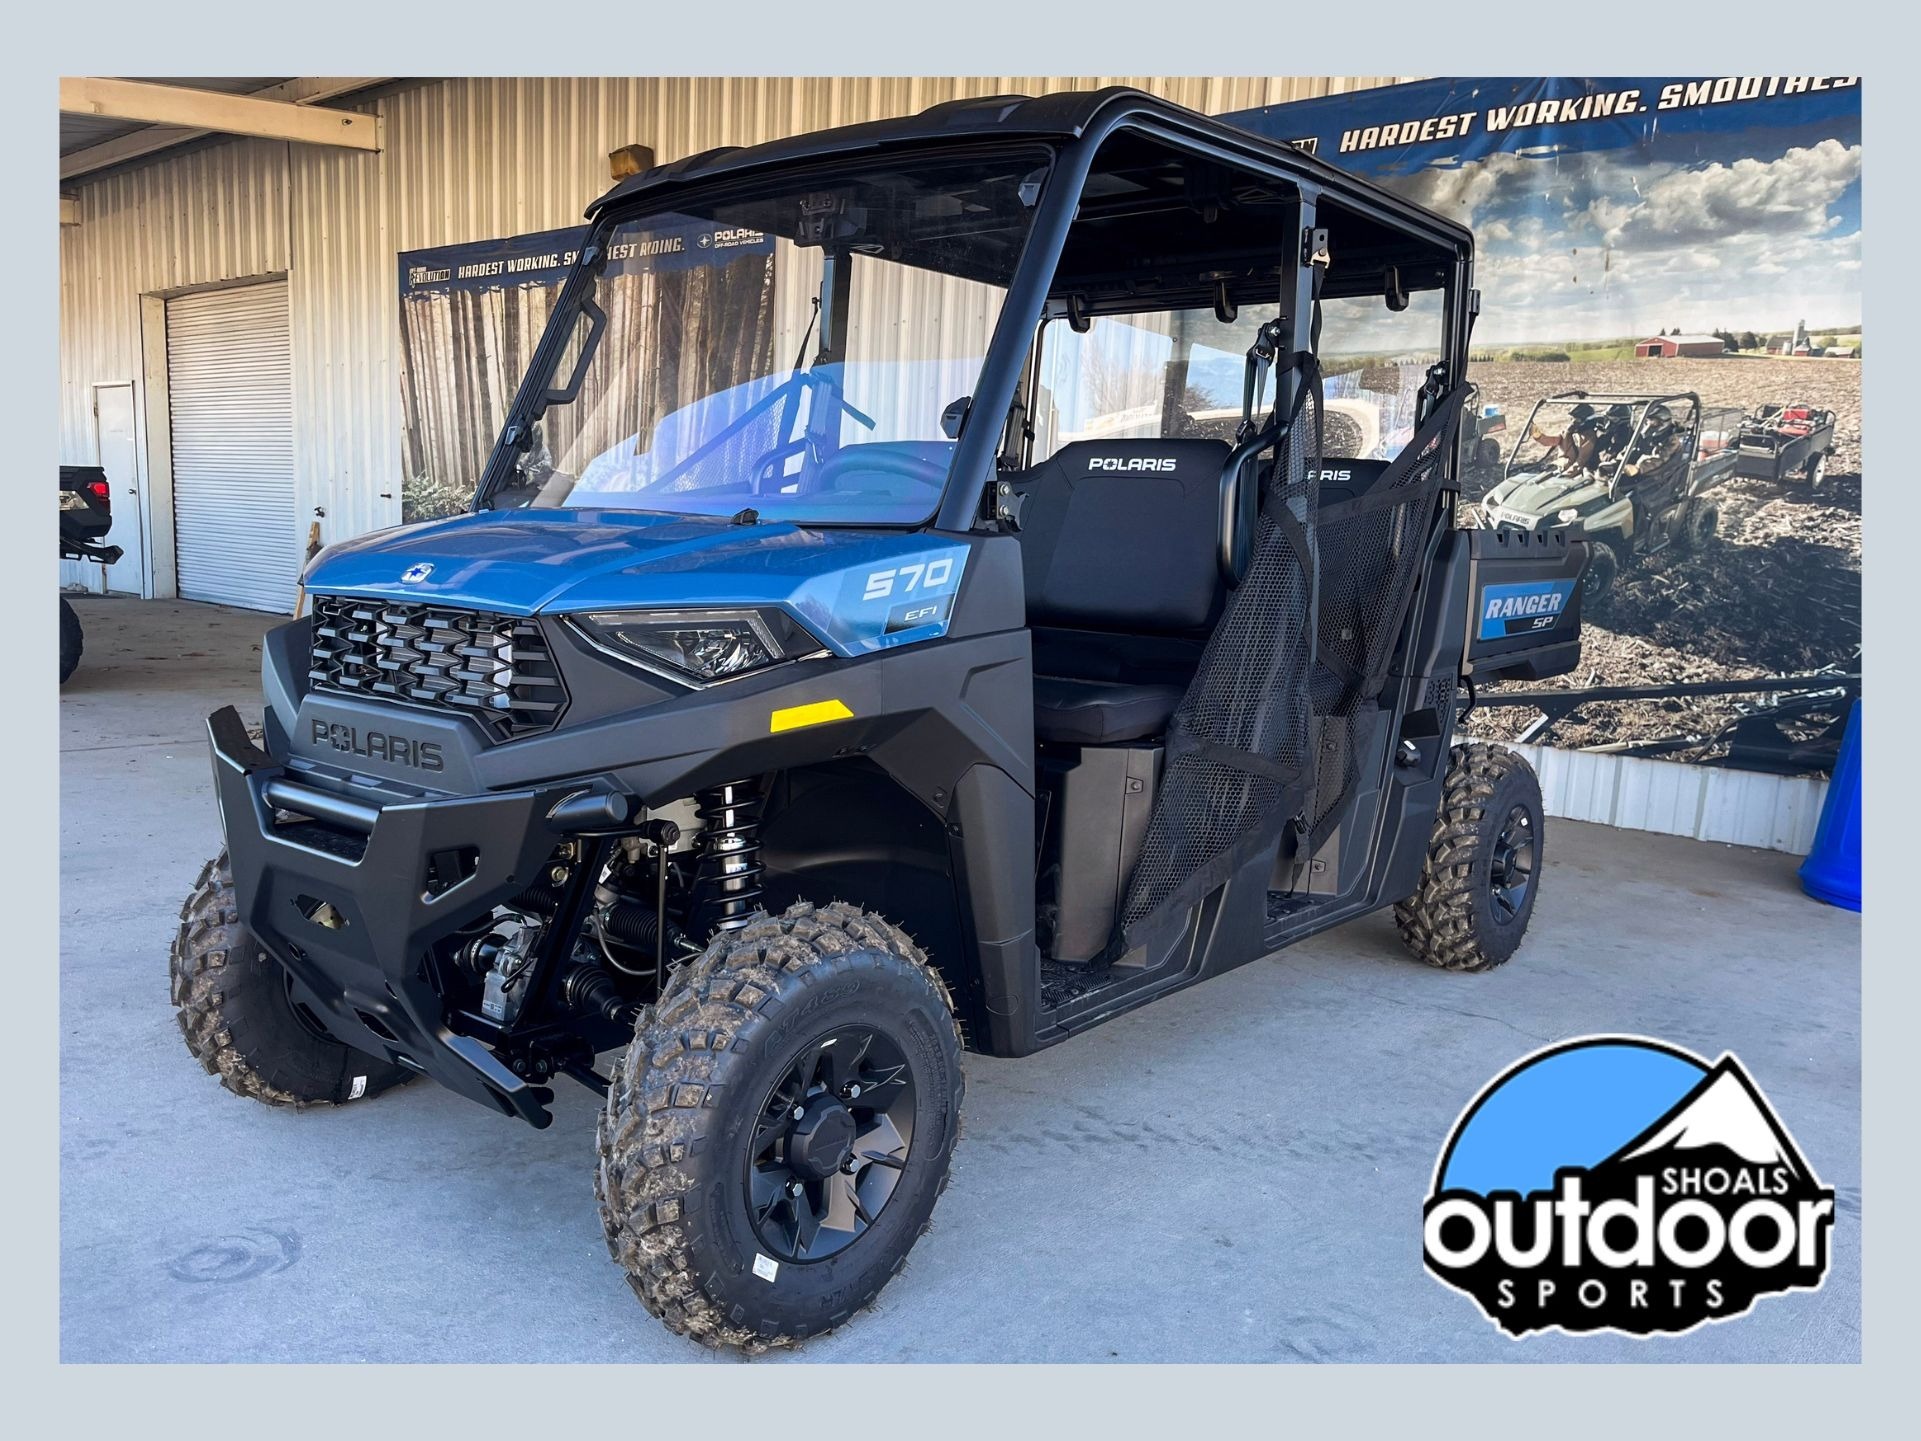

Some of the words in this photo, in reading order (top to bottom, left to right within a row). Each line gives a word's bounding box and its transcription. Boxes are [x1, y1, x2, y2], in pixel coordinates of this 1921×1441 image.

[1339, 112, 1478, 153] HARDEST
[1486, 90, 1647, 132] WORKING.
[458, 261, 504, 279] HARDEST
[507, 250, 561, 273] WORKING.
[1088, 458, 1177, 472] POLARIS
[904, 605, 938, 621] EFI
[1485, 593, 1562, 619] RANGER
[1531, 616, 1554, 629] SP
[312, 718, 444, 773] POLARIS
